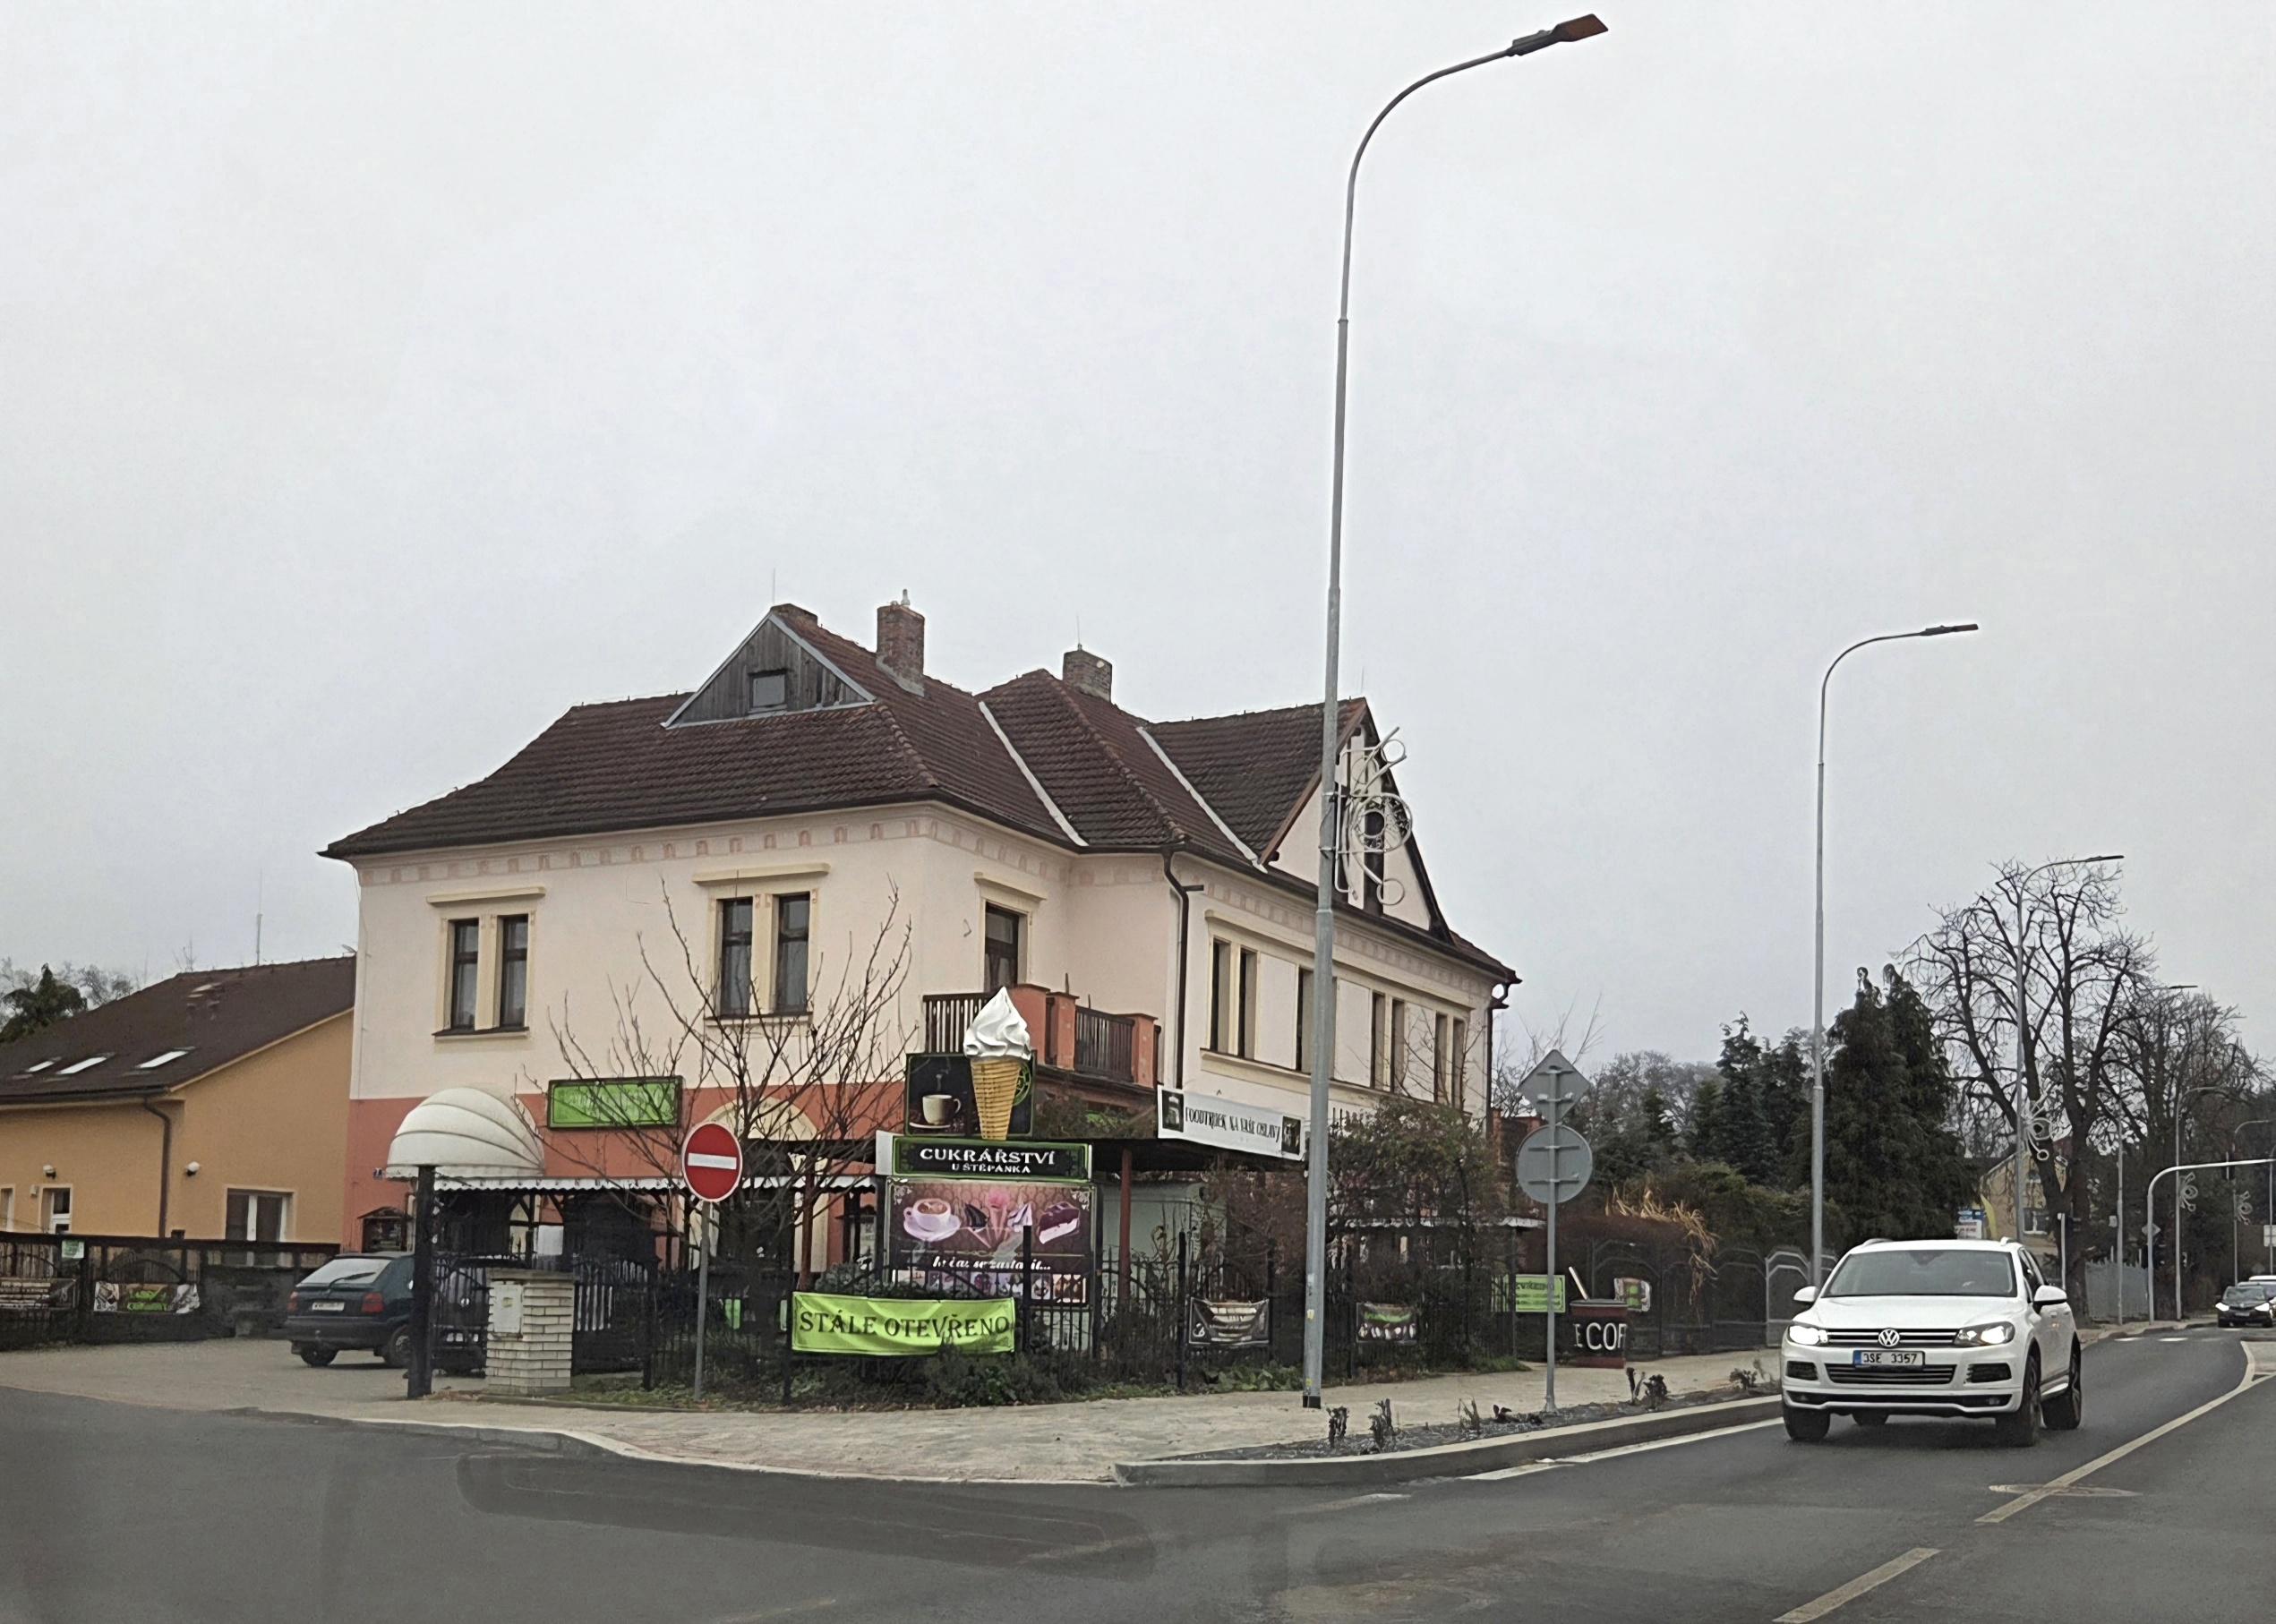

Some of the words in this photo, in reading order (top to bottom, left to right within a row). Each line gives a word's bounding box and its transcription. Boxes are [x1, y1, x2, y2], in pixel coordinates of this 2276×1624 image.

[1229, 1115, 1239, 1132] NA
[920, 1148, 1056, 1165] CUKRÁŘSTVÍ
[952, 1163, 960, 1171] U
[963, 1163, 1031, 1174] ŠTĚPÁNKA
[800, 1309, 877, 1336] STÁLE
[884, 1313, 1010, 1339] OTEVŘENO
